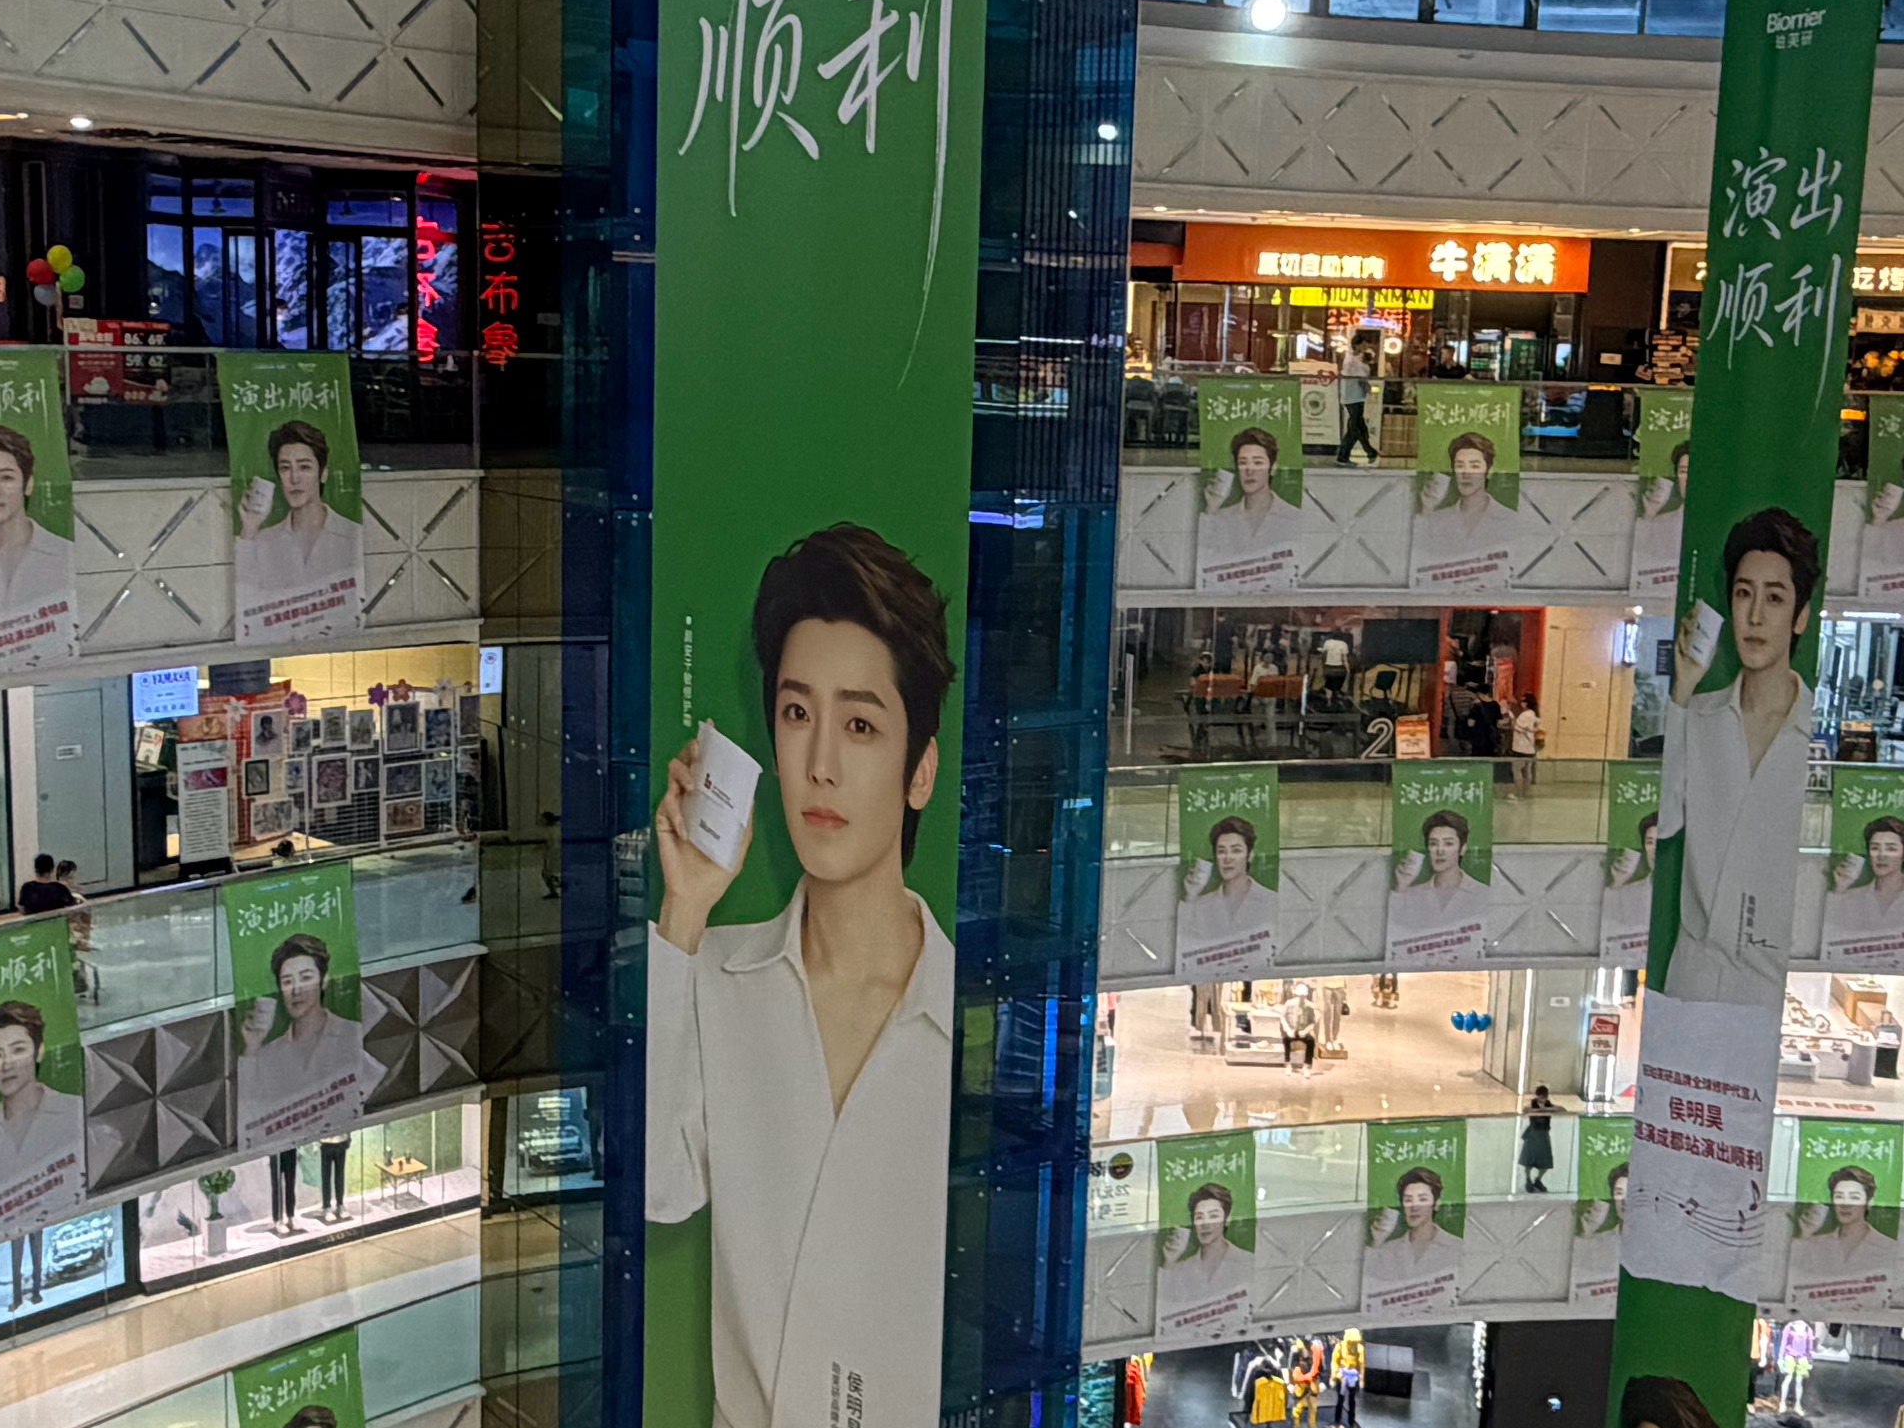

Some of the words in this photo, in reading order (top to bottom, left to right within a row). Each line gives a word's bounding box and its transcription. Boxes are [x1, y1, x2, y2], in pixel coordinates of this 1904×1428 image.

[1723, 146, 1841, 241] 演出
[1428, 239, 1558, 284] 牛满满
[1707, 252, 1842, 417] 顺利
[232, 379, 340, 421] 演出顺利
[1207, 397, 1293, 431] 演出顺利
[1424, 402, 1512, 433] 演出顺利
[1649, 406, 1691, 431] 演出
[1187, 784, 1271, 811] 演出顺利
[1400, 779, 1485, 805] 演出顺利
[237, 886, 345, 936] 演出顺利
[1669, 1096, 1724, 1131] 侯明昊
[1374, 1136, 1458, 1163] 演出顺利
[245, 1350, 349, 1420] 演出顺利
